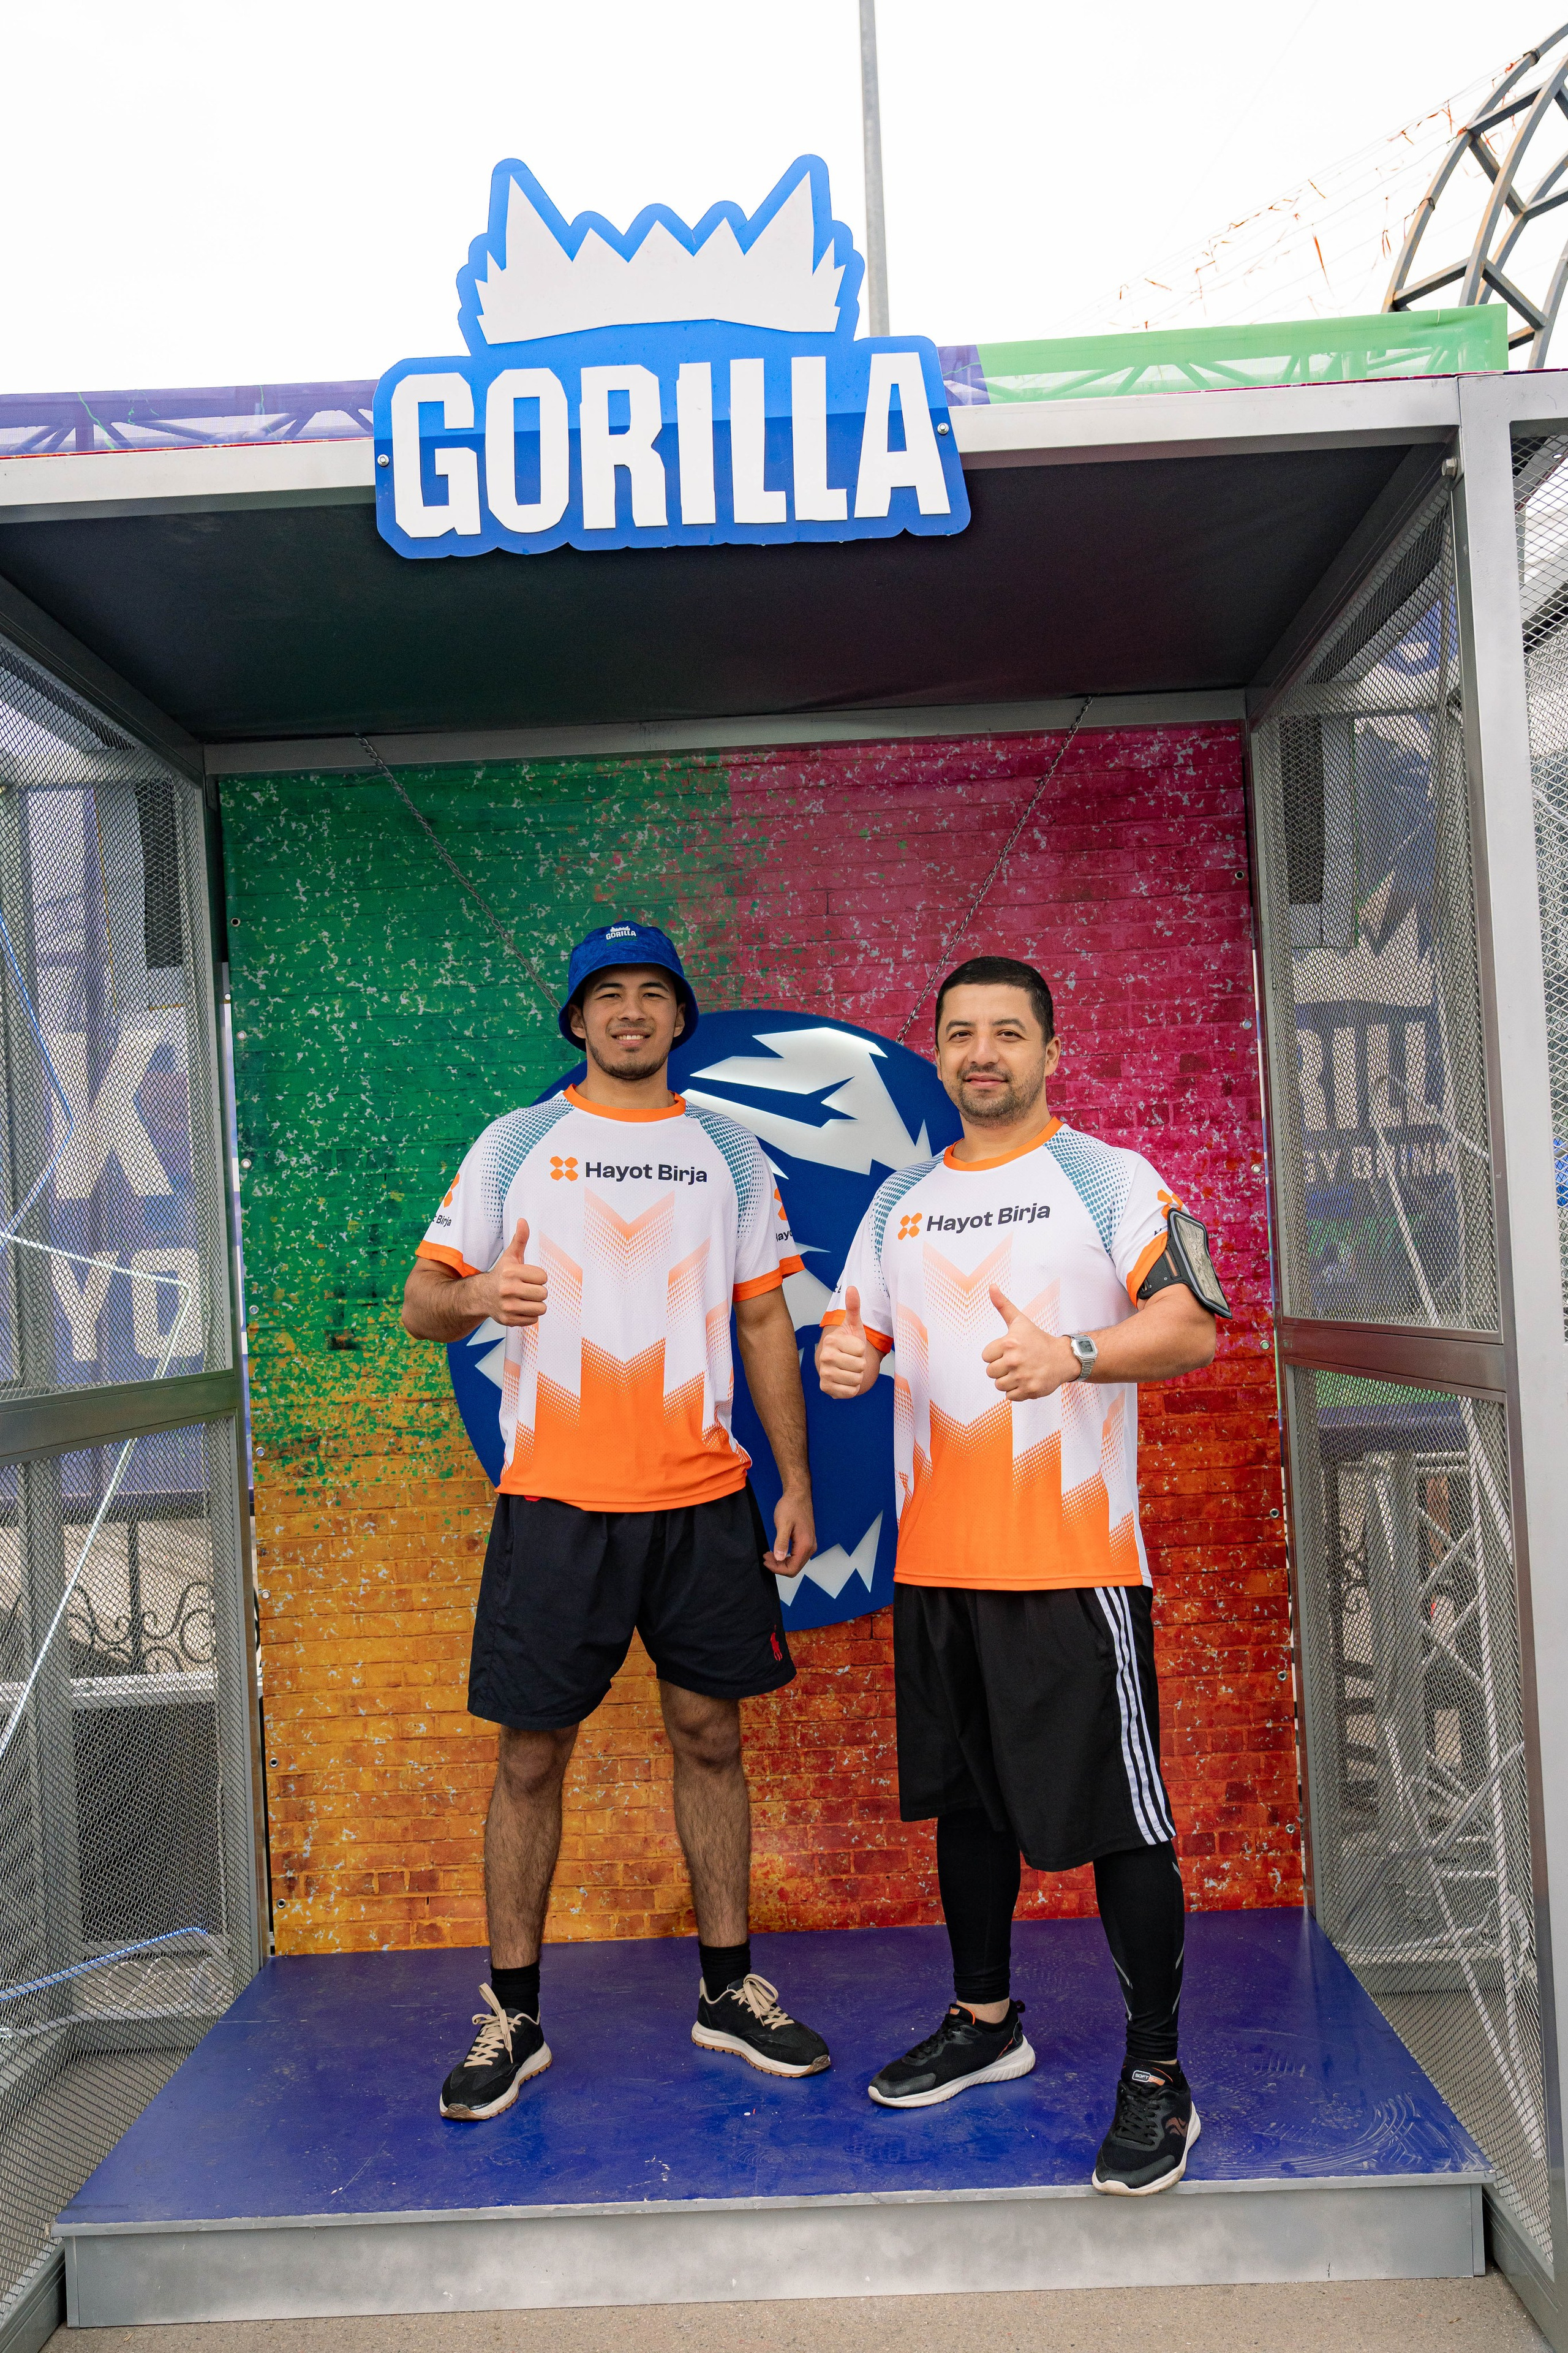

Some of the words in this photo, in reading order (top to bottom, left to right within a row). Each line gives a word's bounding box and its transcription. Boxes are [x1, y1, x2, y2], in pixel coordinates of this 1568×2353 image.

[391, 352, 951, 538] GORILLA
[606, 930, 636, 940] GORILLA
[586, 1161, 653, 1182] Hayot
[658, 1163, 707, 1185] Birja
[436, 1215, 452, 1227] Birja
[926, 1211, 993, 1234] Hayot
[997, 1203, 1050, 1225] Birja
